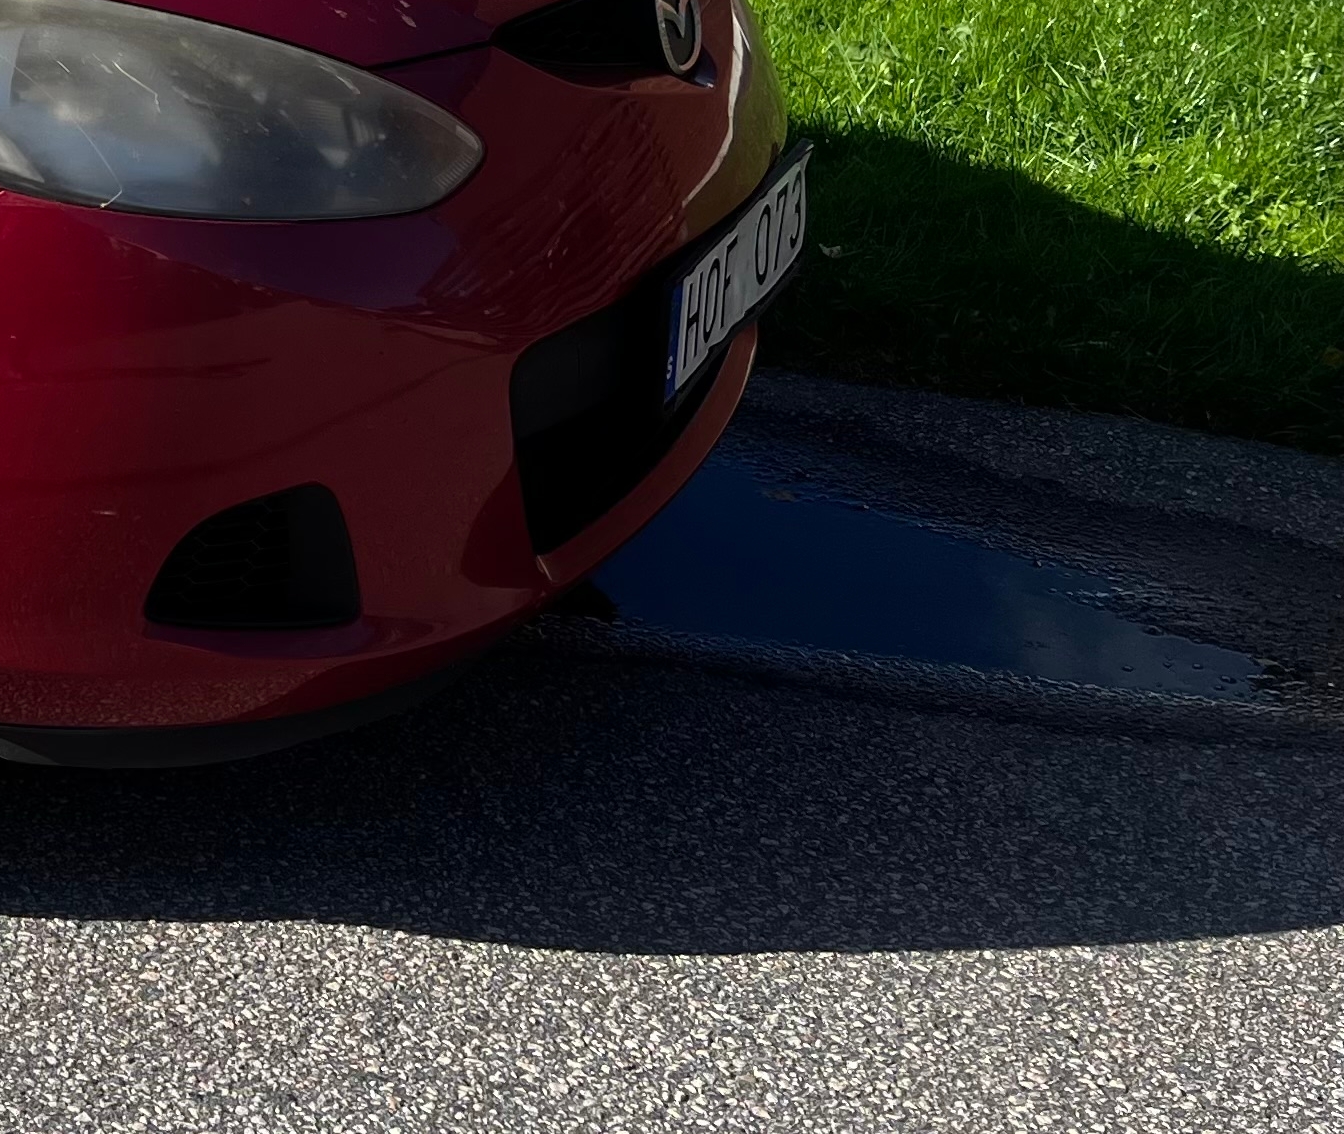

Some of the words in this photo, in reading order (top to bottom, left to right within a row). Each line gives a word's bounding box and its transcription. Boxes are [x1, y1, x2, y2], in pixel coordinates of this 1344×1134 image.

[681, 233, 738, 370] HOF
[754, 167, 802, 286] 073
[665, 355, 673, 380] S
